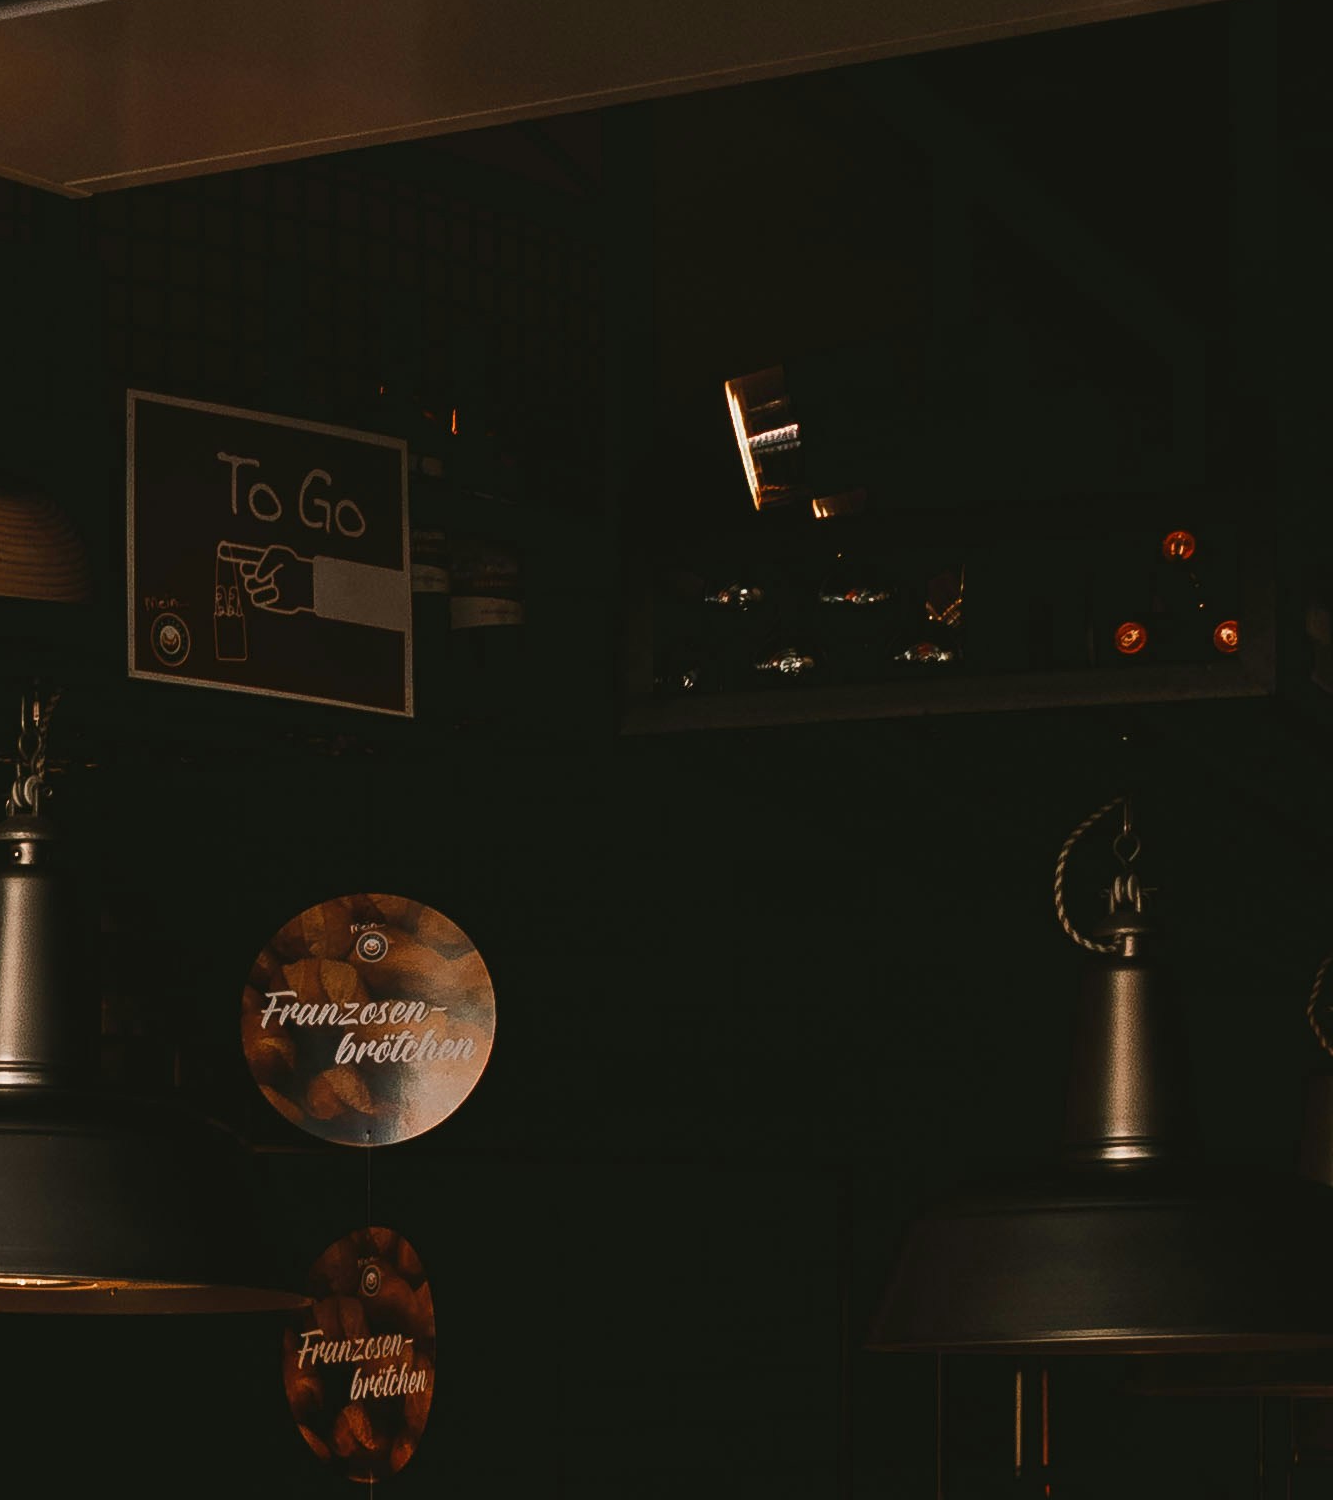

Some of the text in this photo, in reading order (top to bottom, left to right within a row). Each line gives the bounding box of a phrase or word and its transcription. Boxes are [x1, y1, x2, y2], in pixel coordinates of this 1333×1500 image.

[217, 451, 366, 538] To Go
[260, 990, 448, 1030] Franzosen-
[334, 1028, 477, 1066] brötchen
[297, 1329, 414, 1369] Franzosen-
[350, 1362, 428, 1400] brötchen
